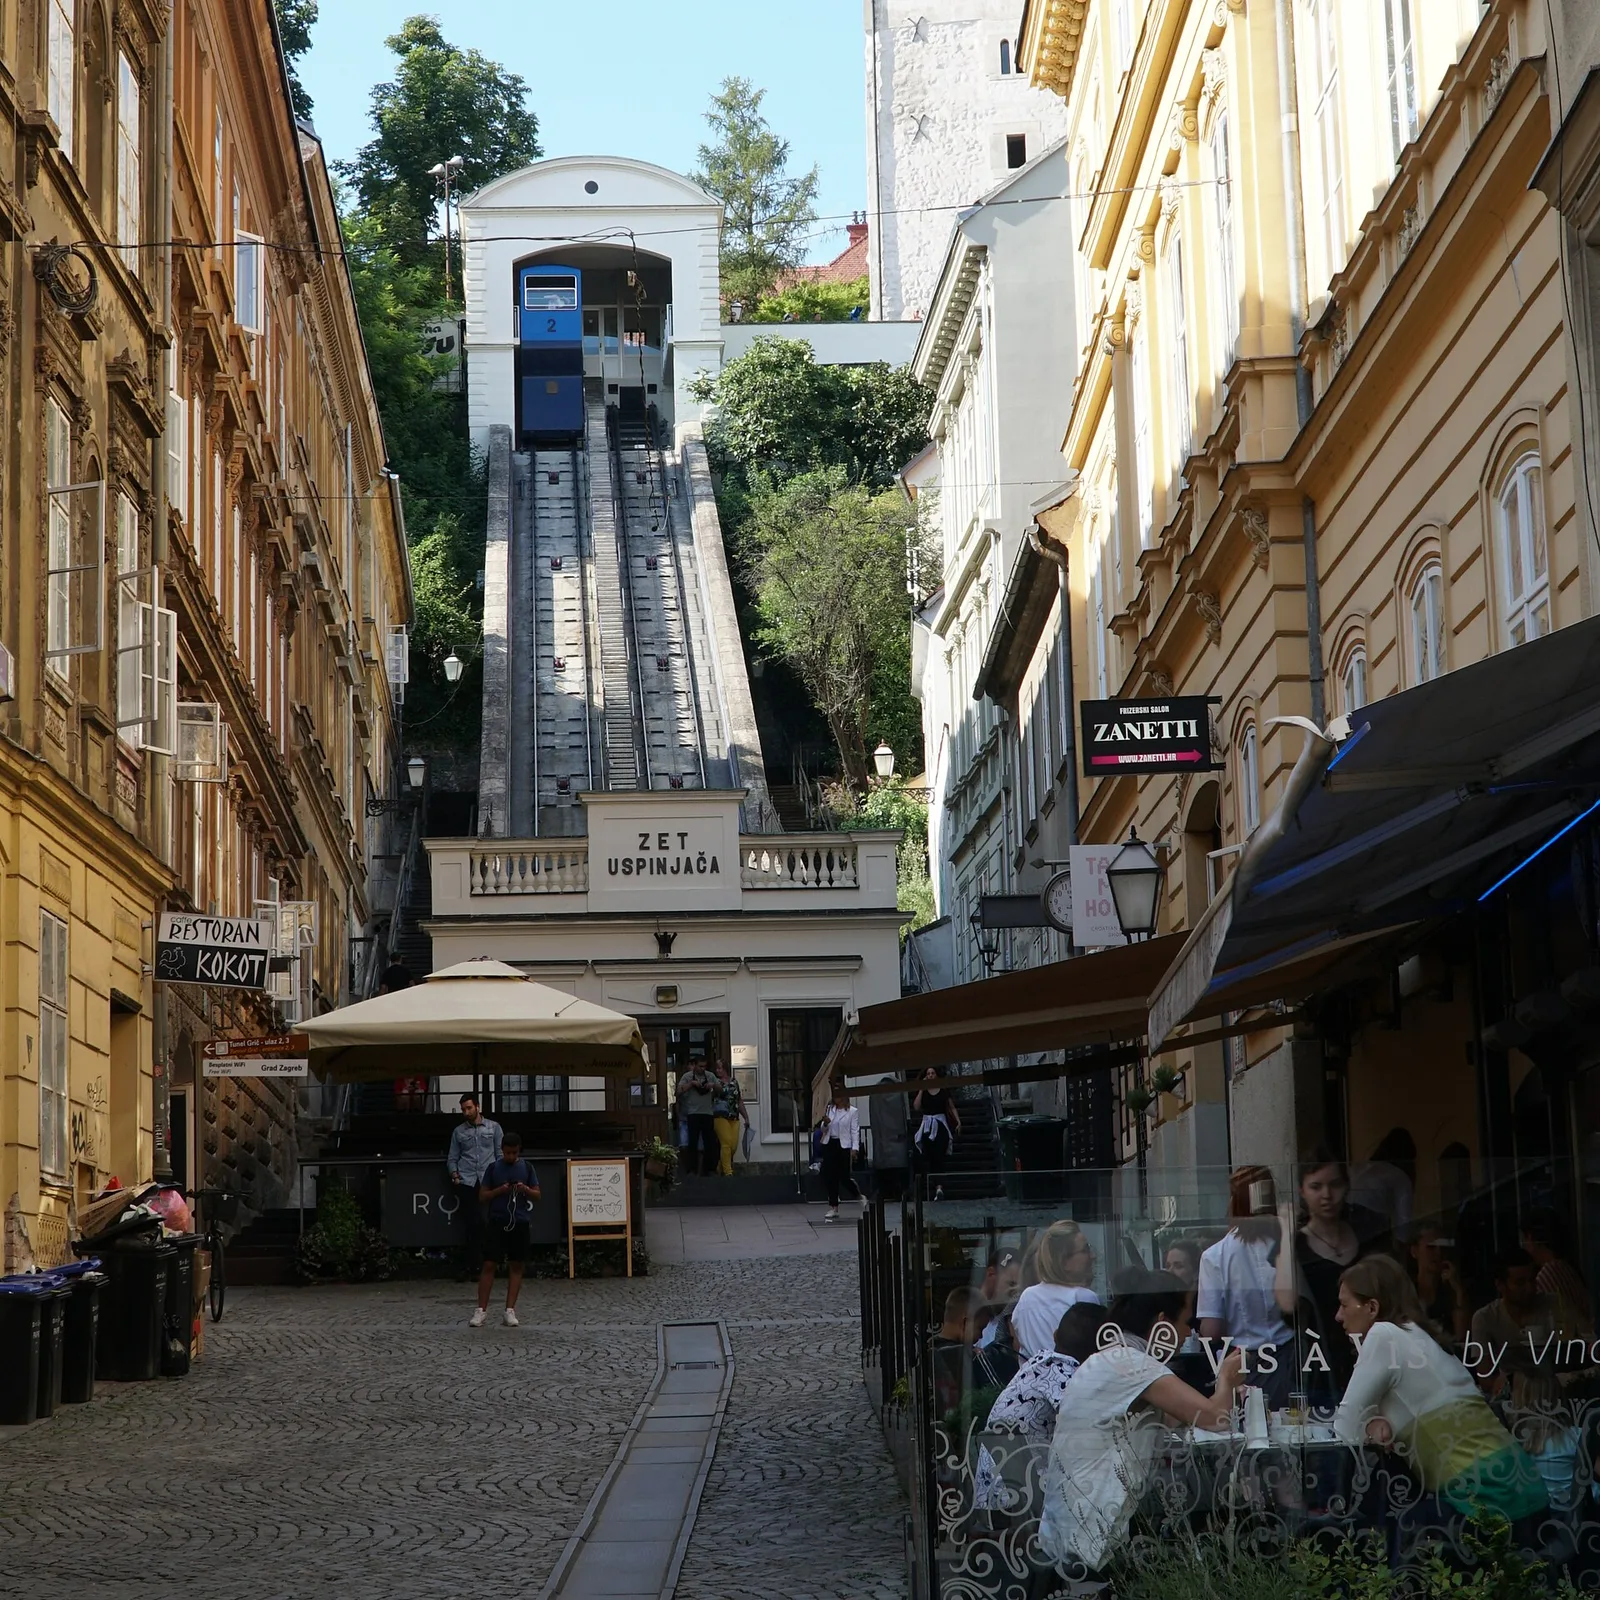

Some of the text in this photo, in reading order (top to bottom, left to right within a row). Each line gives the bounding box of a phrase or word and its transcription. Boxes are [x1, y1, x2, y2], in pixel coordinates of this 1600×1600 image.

[546, 319, 557, 333] 2
[1119, 705, 1170, 715] FRIZERSKI SALON
[1093, 719, 1199, 742] ZANETTI
[1117, 753, 1177, 764] WWW.ZANETTI.HR
[638, 832, 689, 851] ZET
[607, 851, 720, 876] USPINJAČA
[1055, 889, 1063, 898] 10
[168, 918, 260, 945] RESTORAN
[195, 949, 265, 985] KOKOT
[229, 1040, 246, 1048] Tunel
[264, 1038, 278, 1046] ulaz
[208, 1060, 246, 1069] Besplatni WiFi
[261, 1064, 303, 1073] Grad Zagreb
[1462, 1330, 1508, 1378] by
